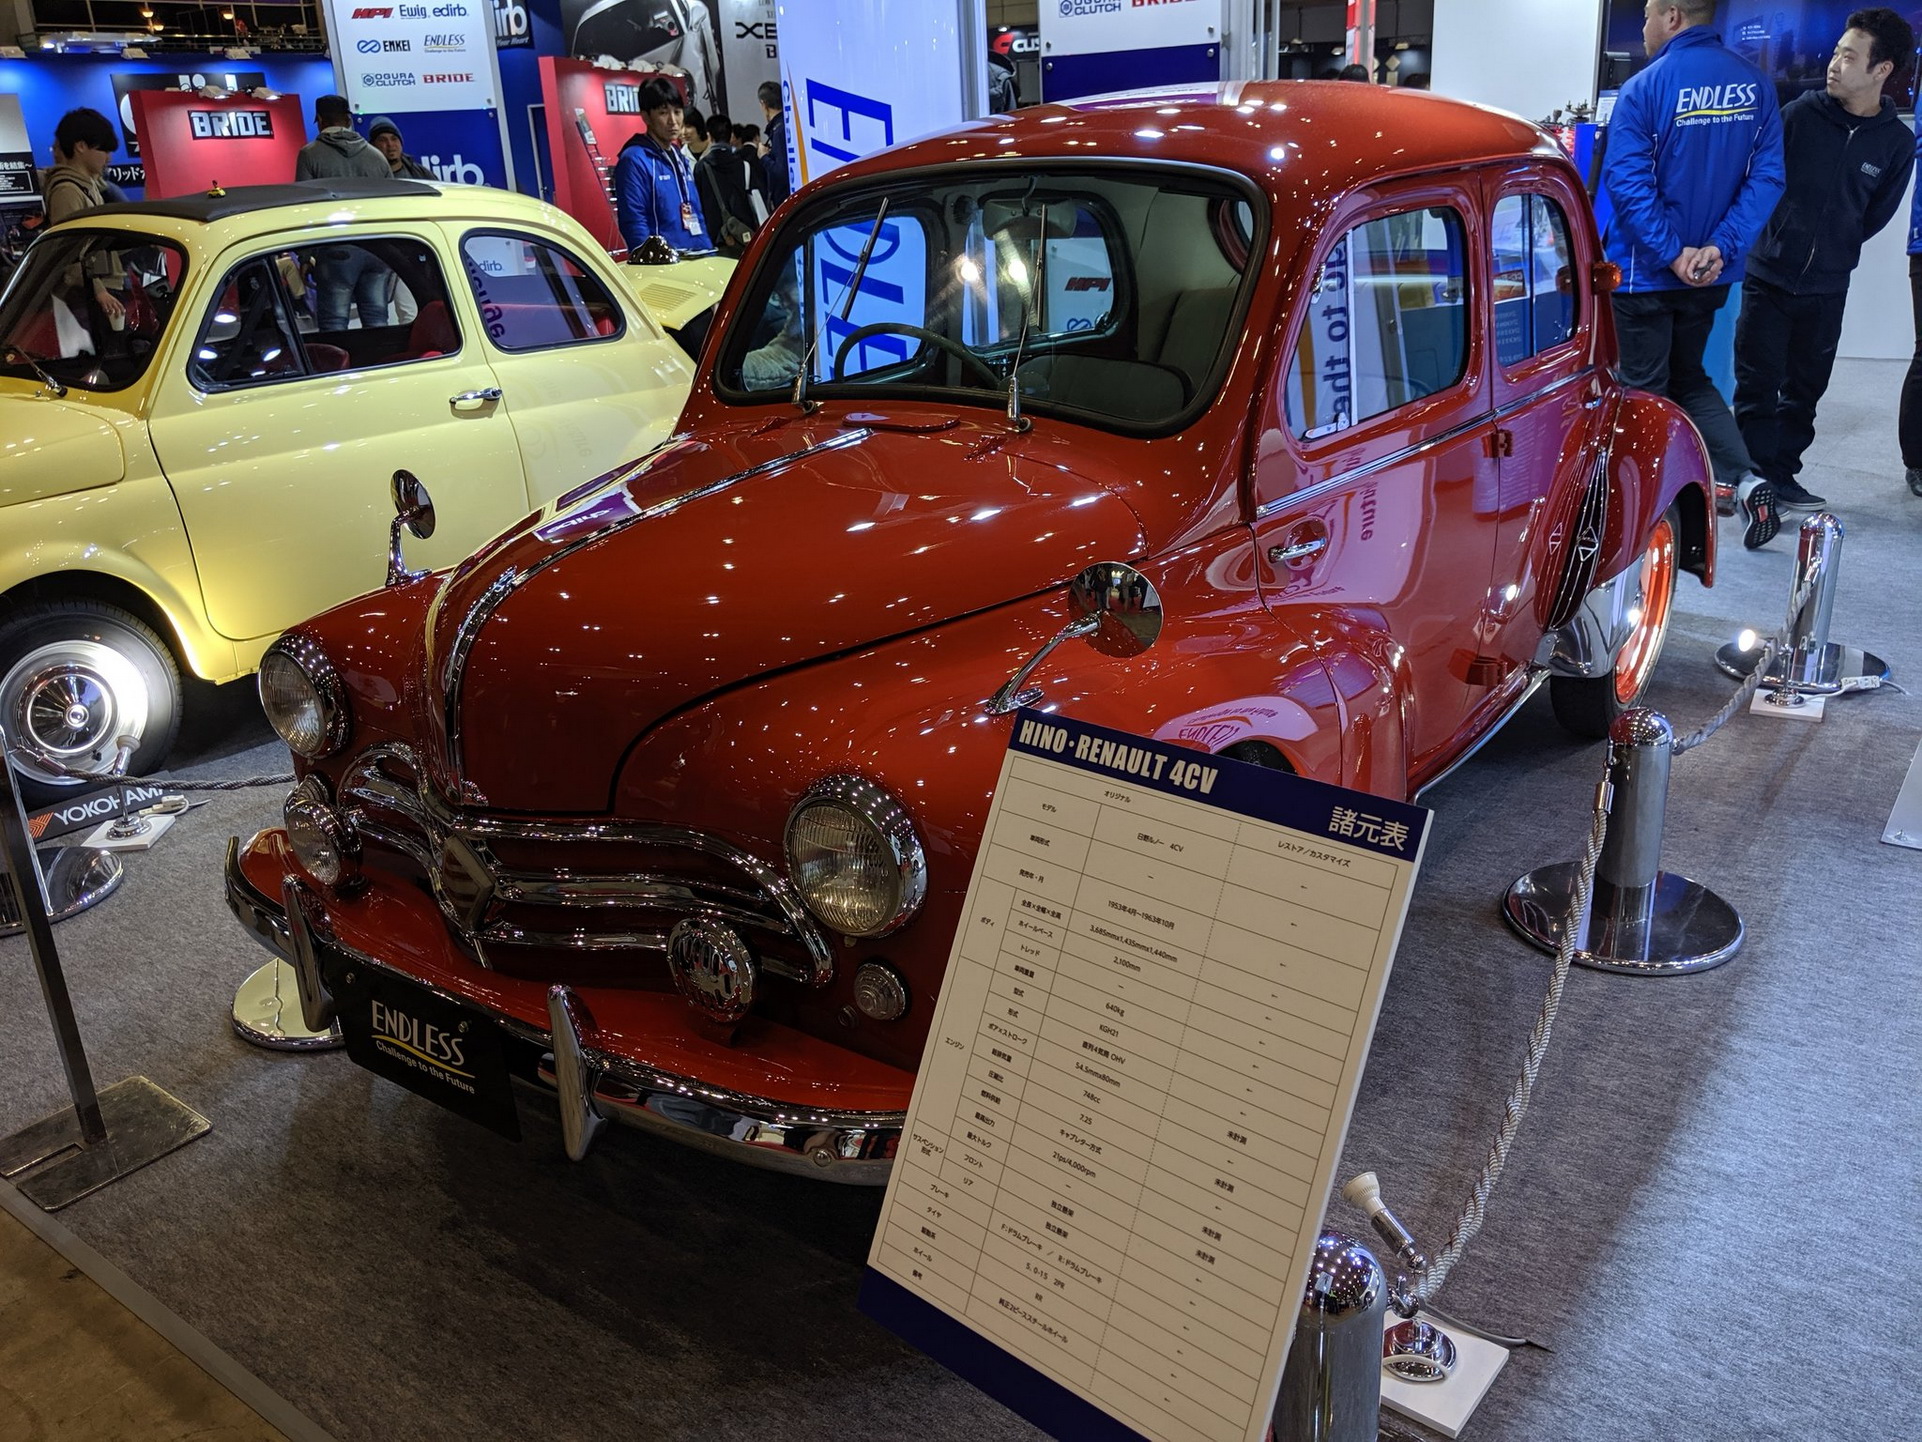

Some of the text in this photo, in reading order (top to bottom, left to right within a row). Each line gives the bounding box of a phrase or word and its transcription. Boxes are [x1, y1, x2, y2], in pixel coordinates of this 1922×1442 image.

[352, 7, 394, 19] HPI
[399, 4, 427, 19] Ewig
[432, 3, 467, 17] edirb
[1074, 3, 1121, 16] CLUTCH
[424, 33, 466, 47] ENDLESS
[375, 72, 415, 80] OGURA
[376, 79, 416, 87] CLUTCH
[423, 73, 475, 84] BRIDE
[1676, 83, 1757, 113] ENDLESS
[190, 112, 271, 137] BRIDE
[1676, 113, 1755, 128] Challenge to the Future
[1064, 277, 1111, 291] HPI
[1168, 759, 1219, 795] 4CV
[1103, 790, 1132, 804] オリジナル
[1041, 803, 1057, 814] モデル
[1328, 806, 1410, 852] 諸元表
[1029, 834, 1051, 848] 車両形式
[1137, 832, 1185, 853] 日野ルノー 4CV
[980, 916, 995, 927] ボディ
[1017, 920, 1054, 939] ホイールベース
[1020, 943, 1041, 957] トレッド
[1013, 964, 1035, 979] 車両重量
[1112, 955, 1142, 973] 2,100mm
[1006, 1007, 1020, 1019] 形式
[1105, 1001, 1126, 1018] 640kg
[371, 999, 465, 1067] ENDLESS
[944, 1036, 965, 1051] エンジン
[1110, 1050, 1127, 1066] OHV
[376, 1040, 475, 1095] Challenge to the Future
[1082, 1089, 1102, 1105] 748cc
[1079, 1113, 1093, 1126] 7.25
[912, 1133, 944, 1154] サスペンション
[966, 1130, 992, 1149] 最大トルク
[1059, 1128, 1103, 1156] キャブレター方式
[1226, 1130, 1248, 1146] 未計測
[963, 1153, 984, 1169] フロント
[1051, 1150, 1097, 1179] 21ps/4,000rpm
[963, 1177, 975, 1187] リア
[1213, 1178, 1235, 1194] 未計測
[930, 1183, 950, 1199] ブレーキ
[926, 1206, 943, 1219] タイヤ
[1050, 1199, 1075, 1218] 独立懸架
[1044, 1220, 1069, 1240] 独立懸架
[1201, 1225, 1223, 1242] 未計測
[912, 1246, 933, 1263] ホイール
[1194, 1249, 1216, 1266] 未計測
[1034, 1292, 1044, 1303] RR
